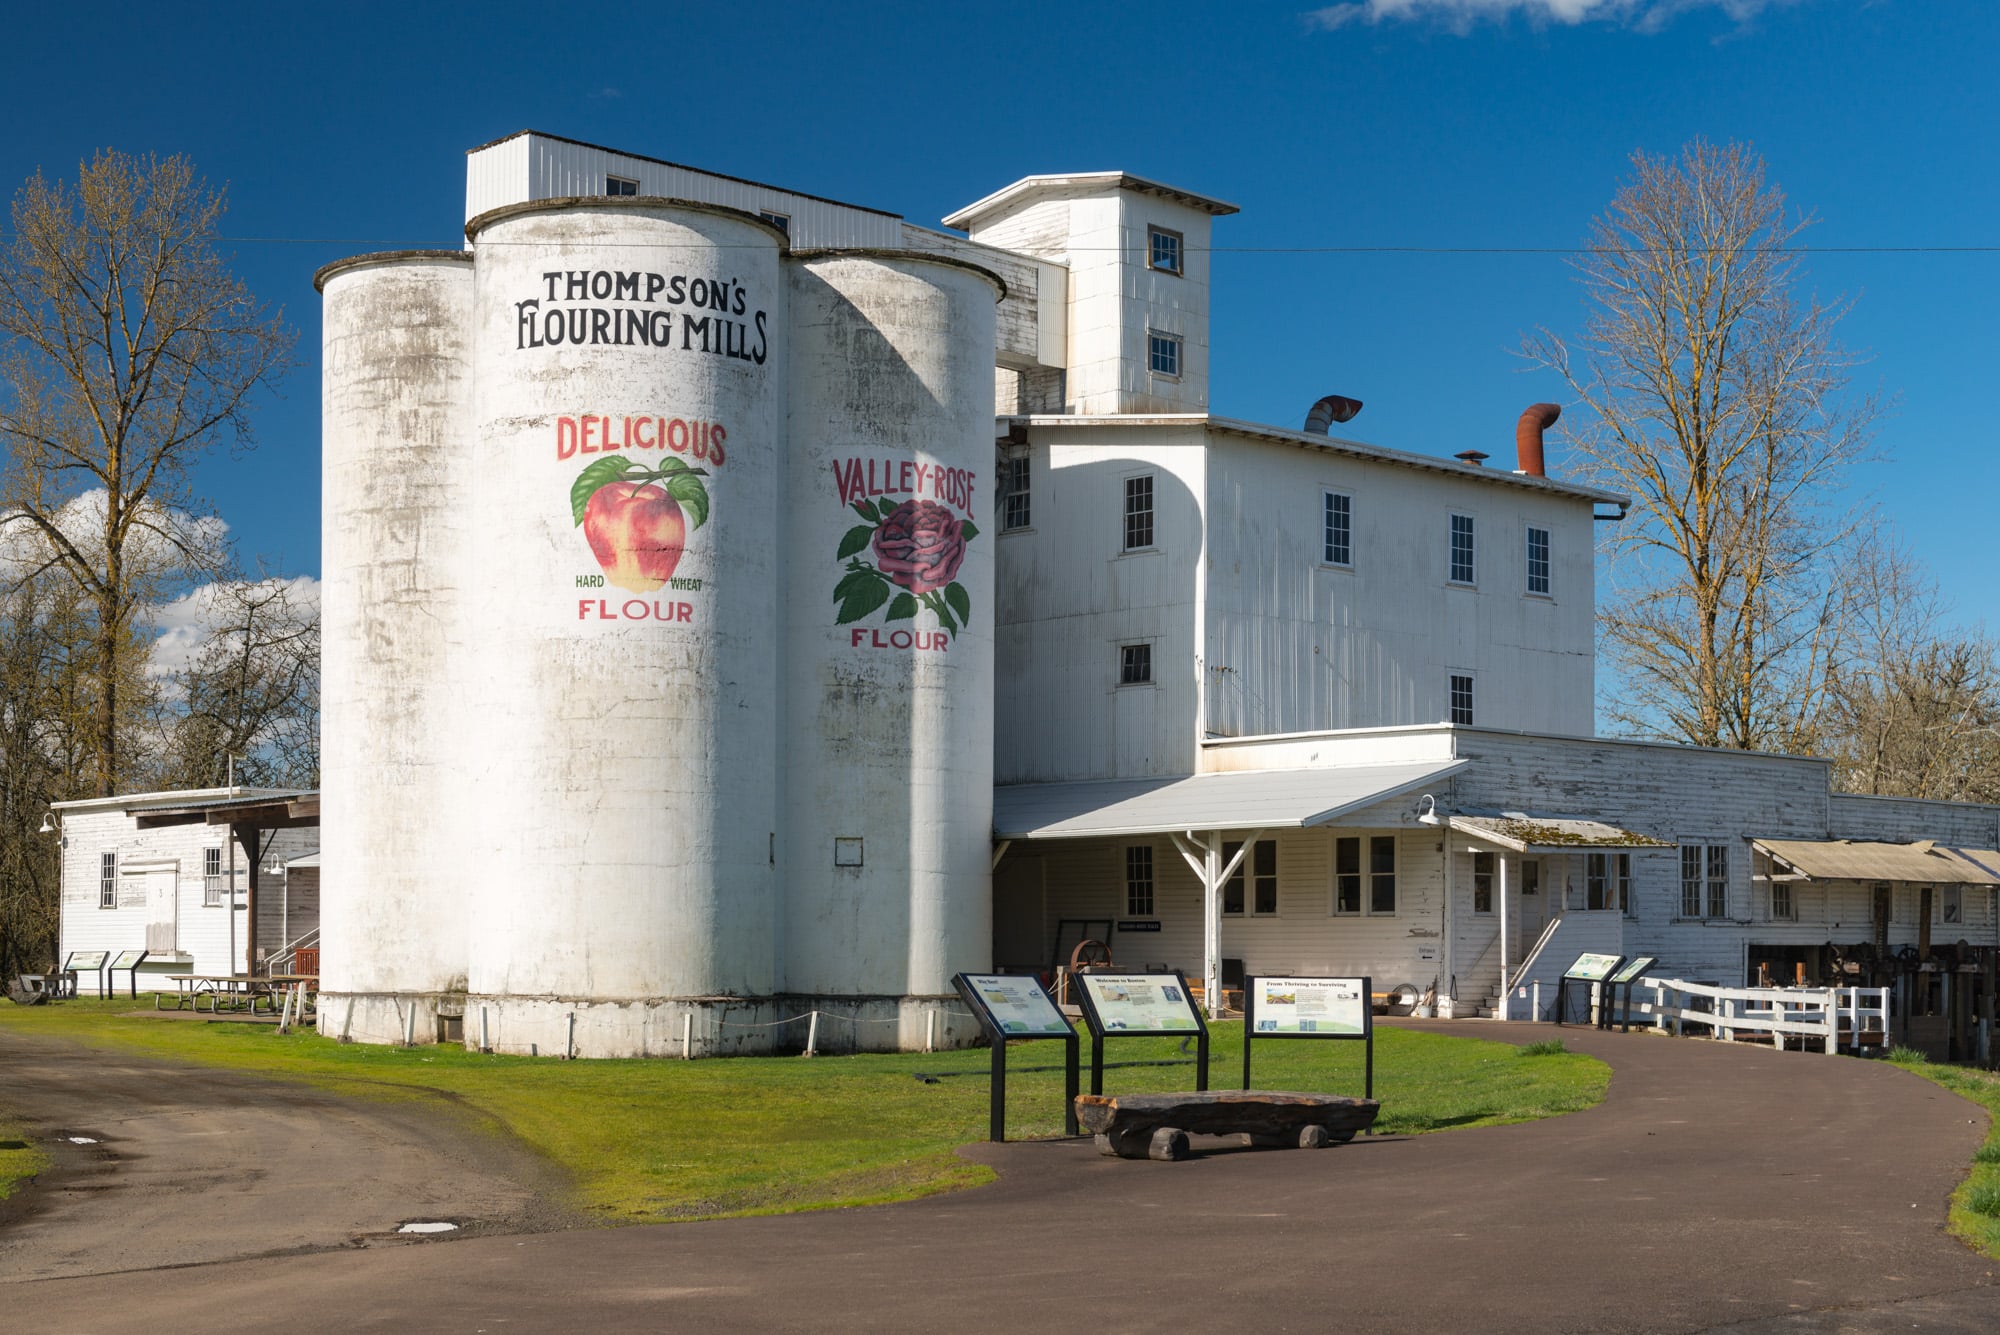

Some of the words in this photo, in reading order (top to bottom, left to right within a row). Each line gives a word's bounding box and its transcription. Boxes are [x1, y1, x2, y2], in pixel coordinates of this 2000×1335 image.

[543, 270, 746, 316] THOMPSON'S
[515, 297, 673, 350] FLOURING
[681, 310, 767, 365] MILLS
[557, 415, 727, 467] DELICIOUS
[833, 457, 976, 520] VALLEY-ROSE
[575, 575, 605, 588] HARD
[670, 576, 703, 592] WHEAT
[578, 599, 694, 623] FLOUR
[851, 628, 949, 652] FLOUR
